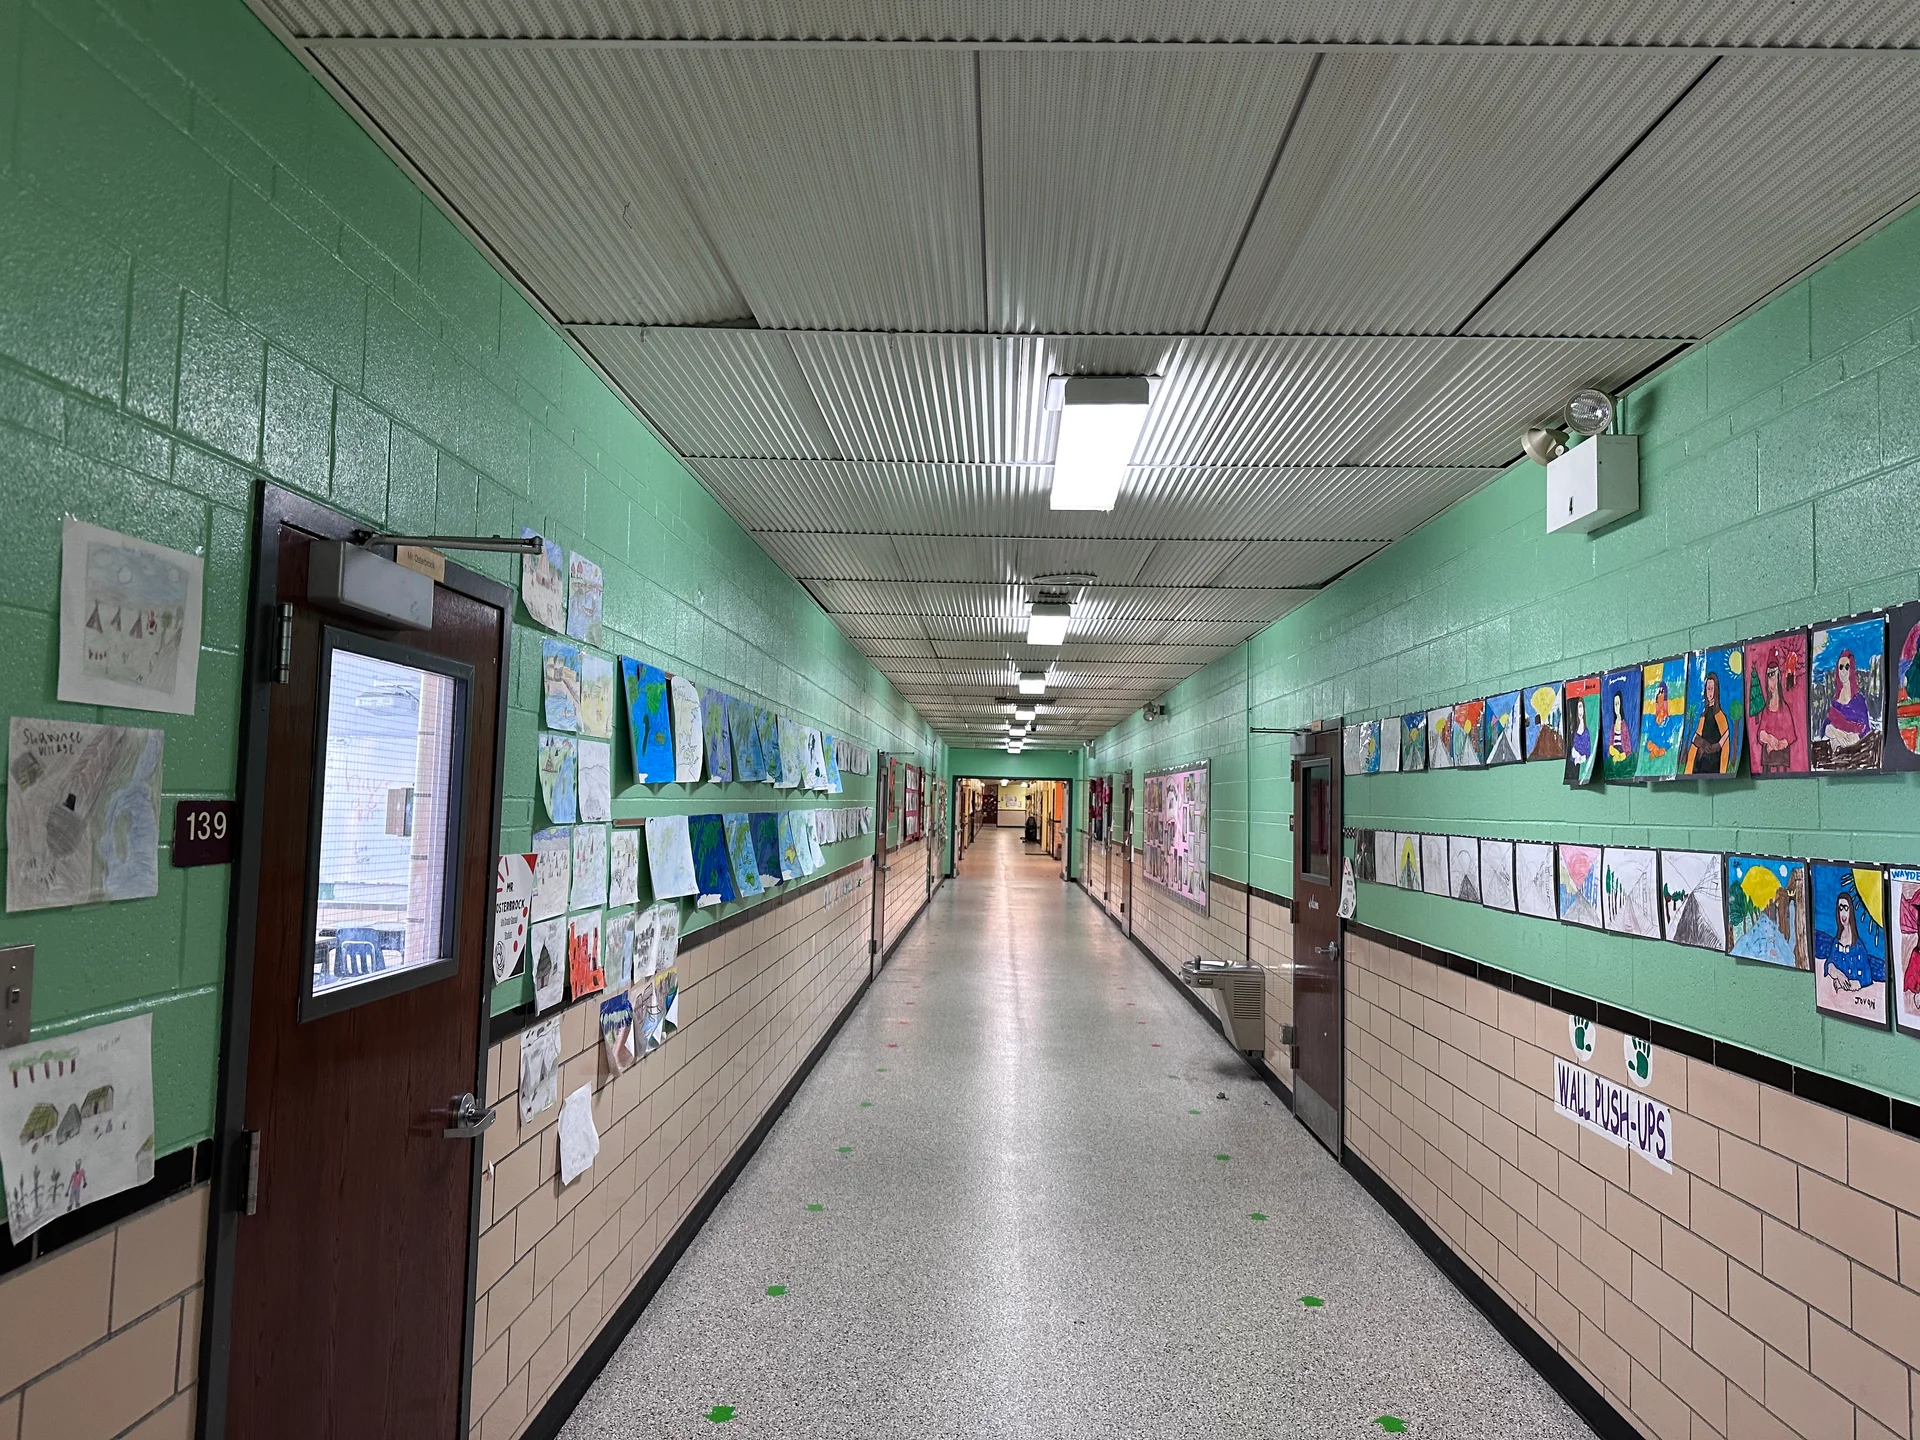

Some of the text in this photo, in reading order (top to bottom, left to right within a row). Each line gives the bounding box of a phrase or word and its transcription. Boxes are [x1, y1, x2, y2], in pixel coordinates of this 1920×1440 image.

[186, 811, 227, 841] 139
[496, 899, 525, 913] OSTERBROCK
[1558, 1062, 1666, 1160] WALL PUSH-UPS
